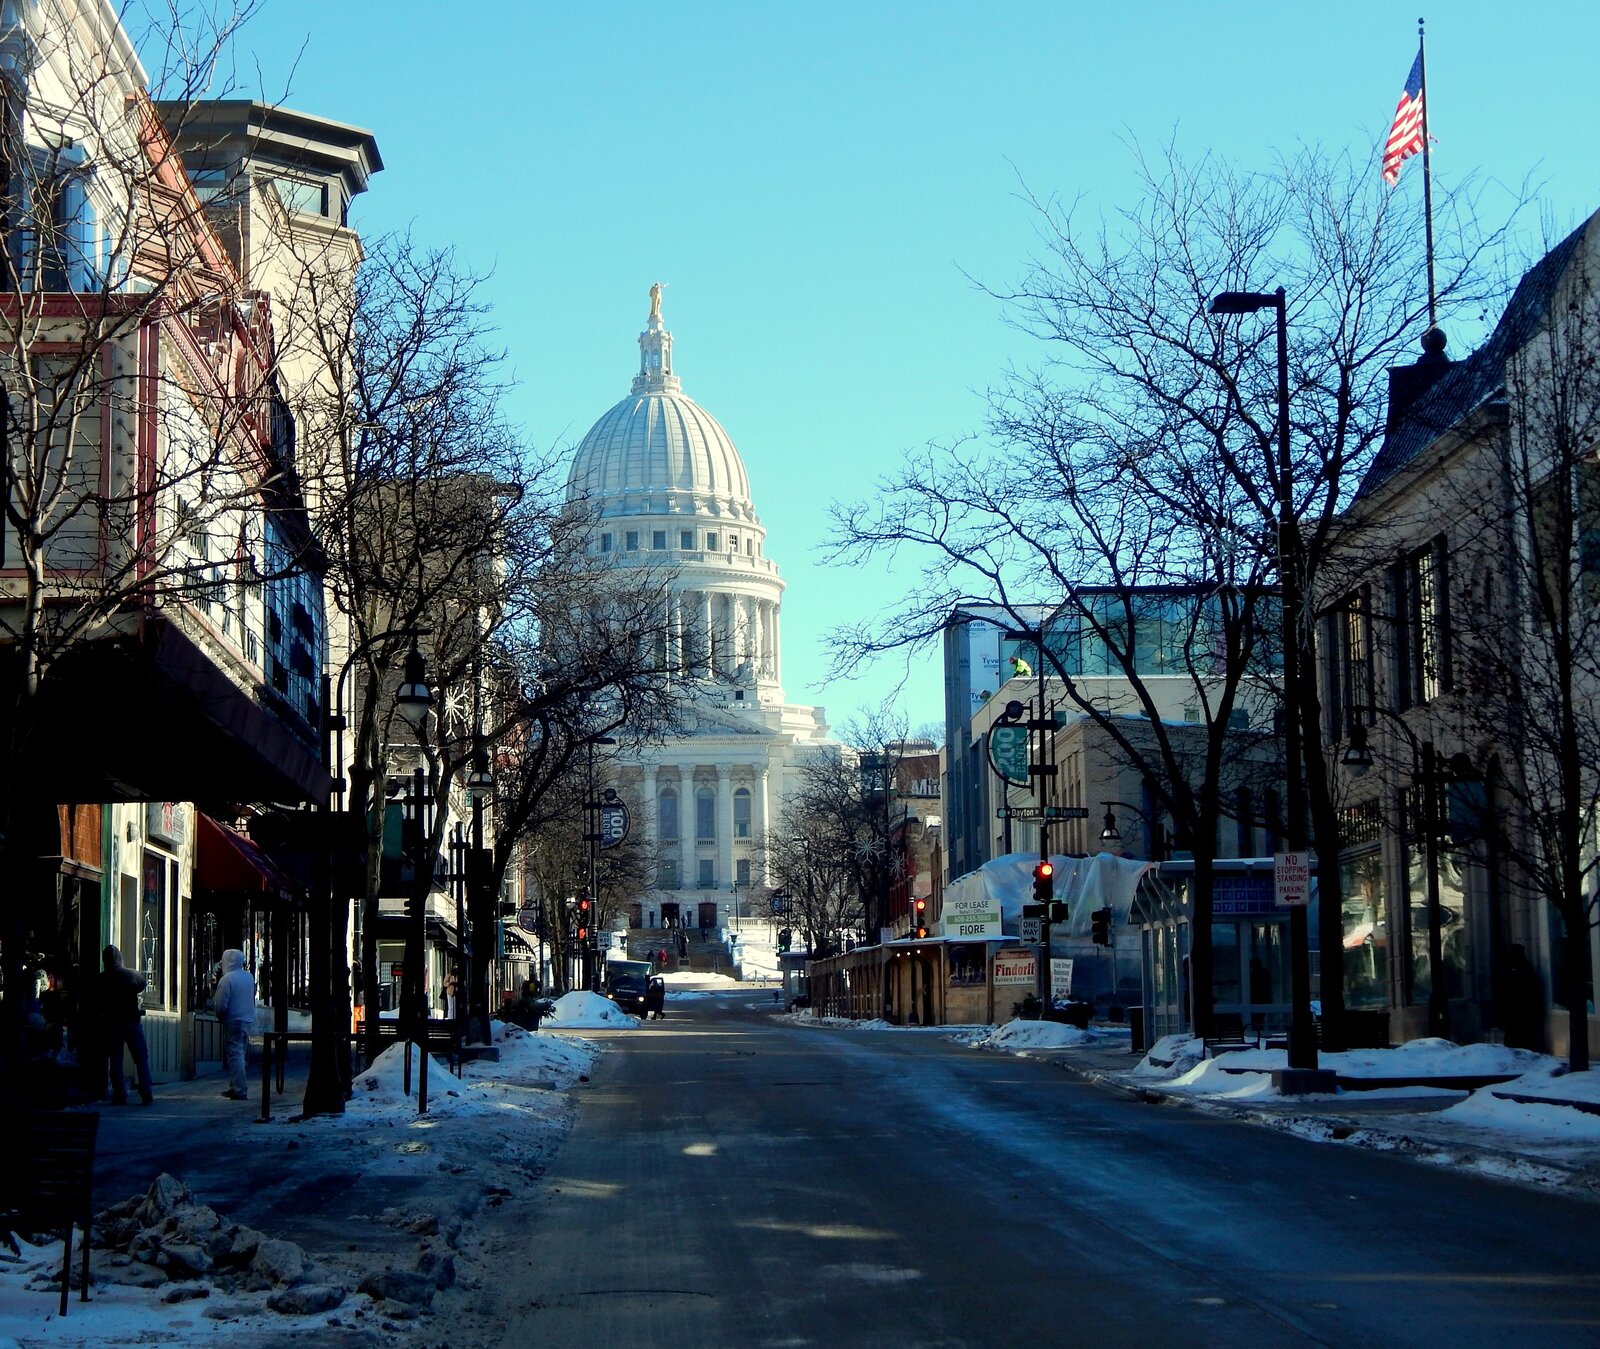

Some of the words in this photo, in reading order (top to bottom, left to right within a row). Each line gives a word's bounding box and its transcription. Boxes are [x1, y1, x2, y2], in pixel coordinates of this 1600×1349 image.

[1011, 808, 1034, 817] Dayton
[602, 813, 611, 839] BLOCK
[610, 808, 624, 838] 100
[1285, 855, 1297, 865] NO
[1276, 866, 1307, 874] STOPPING
[1277, 874, 1307, 883] STANDING
[1279, 885, 1305, 894] PARKING
[969, 900, 989, 908] LEASE
[959, 924, 985, 936] FIORE
[1022, 928, 1038, 936] WAY
[995, 962, 1035, 976] Findorff
